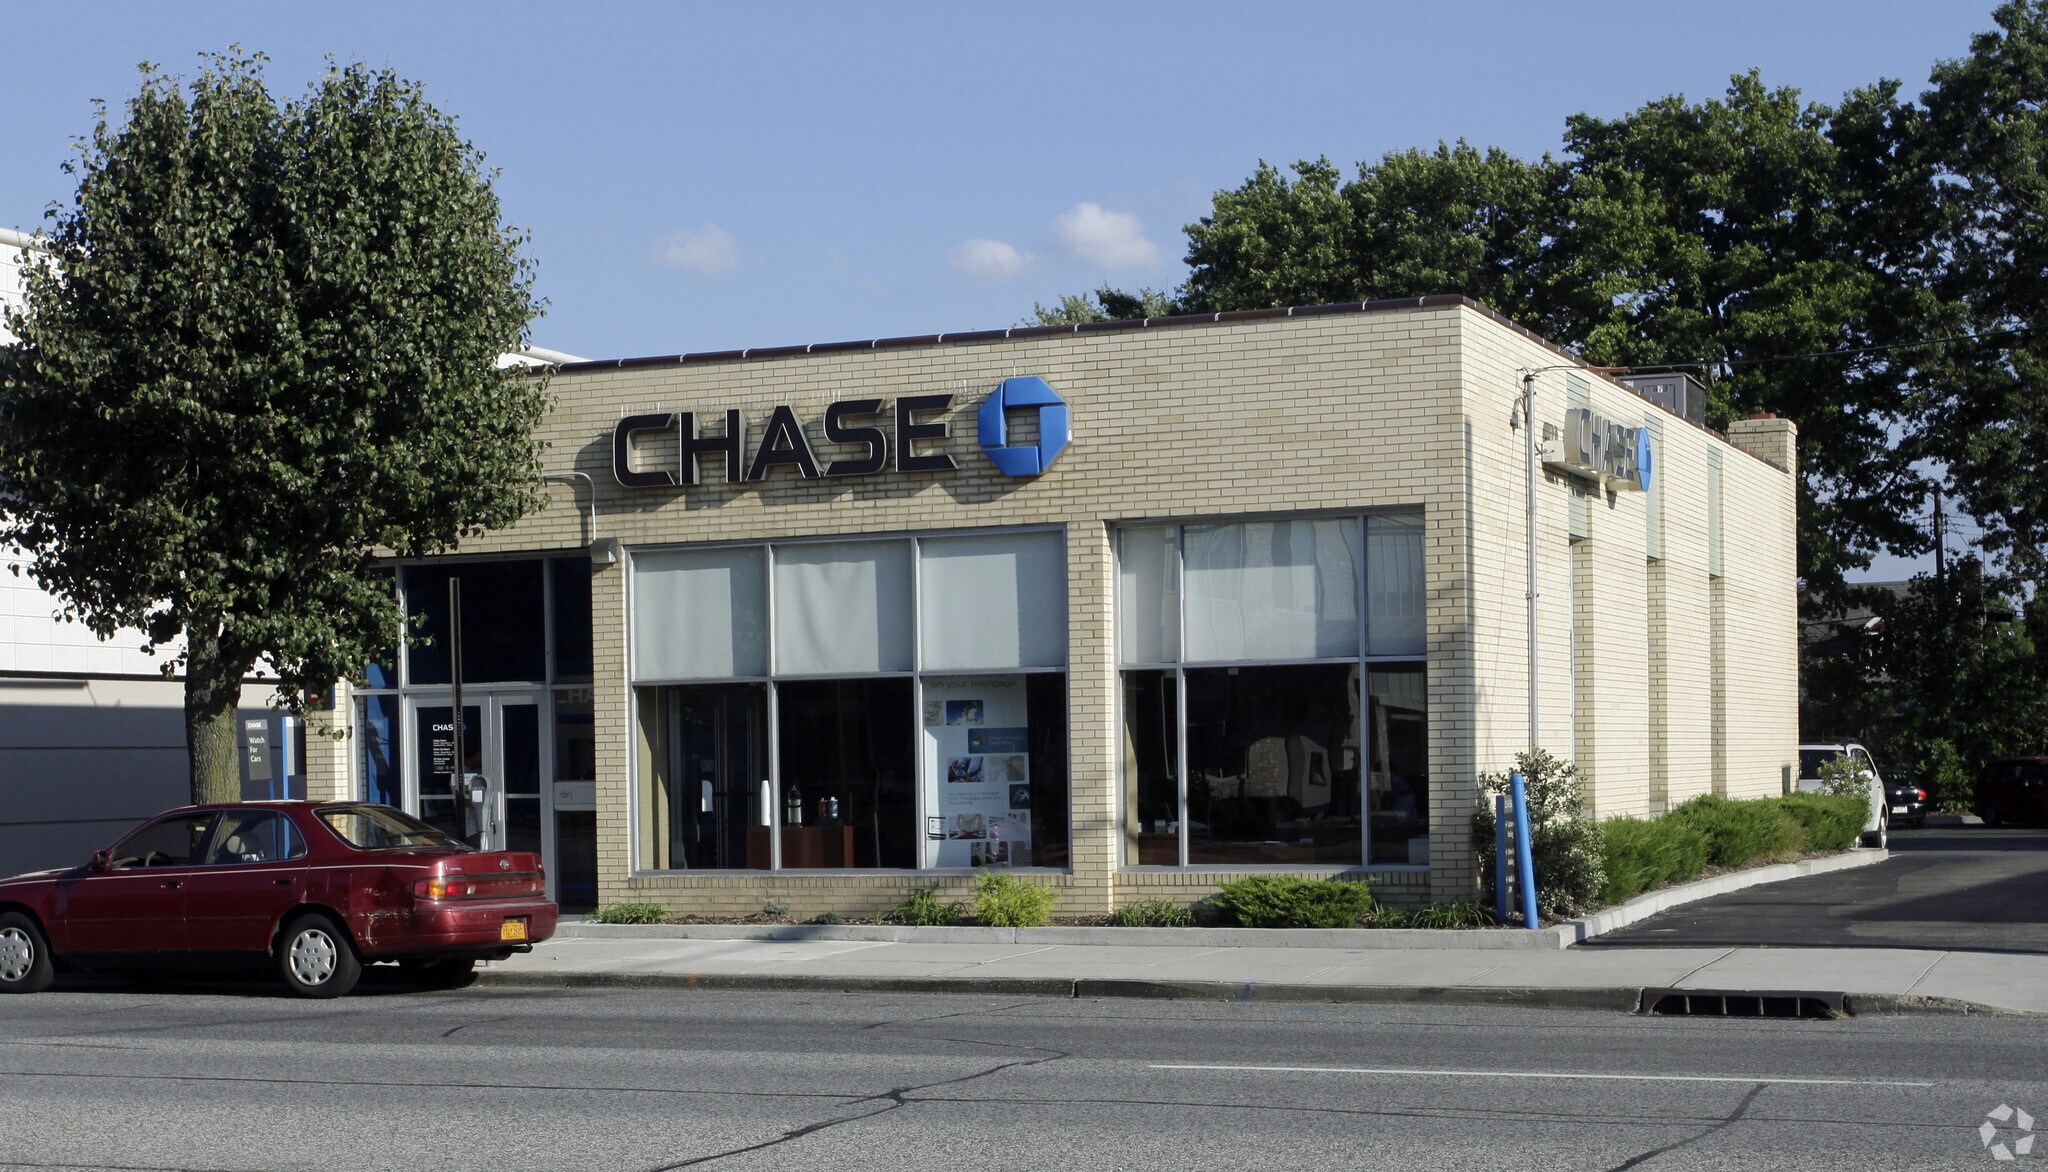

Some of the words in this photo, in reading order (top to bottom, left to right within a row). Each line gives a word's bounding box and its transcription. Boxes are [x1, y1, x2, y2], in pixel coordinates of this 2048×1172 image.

[612, 393, 960, 488] CHASE
[1563, 408, 1637, 481] CHASE
[248, 736, 266, 744] Watch
[249, 746, 258, 754] For
[250, 755, 262, 763] Cars
